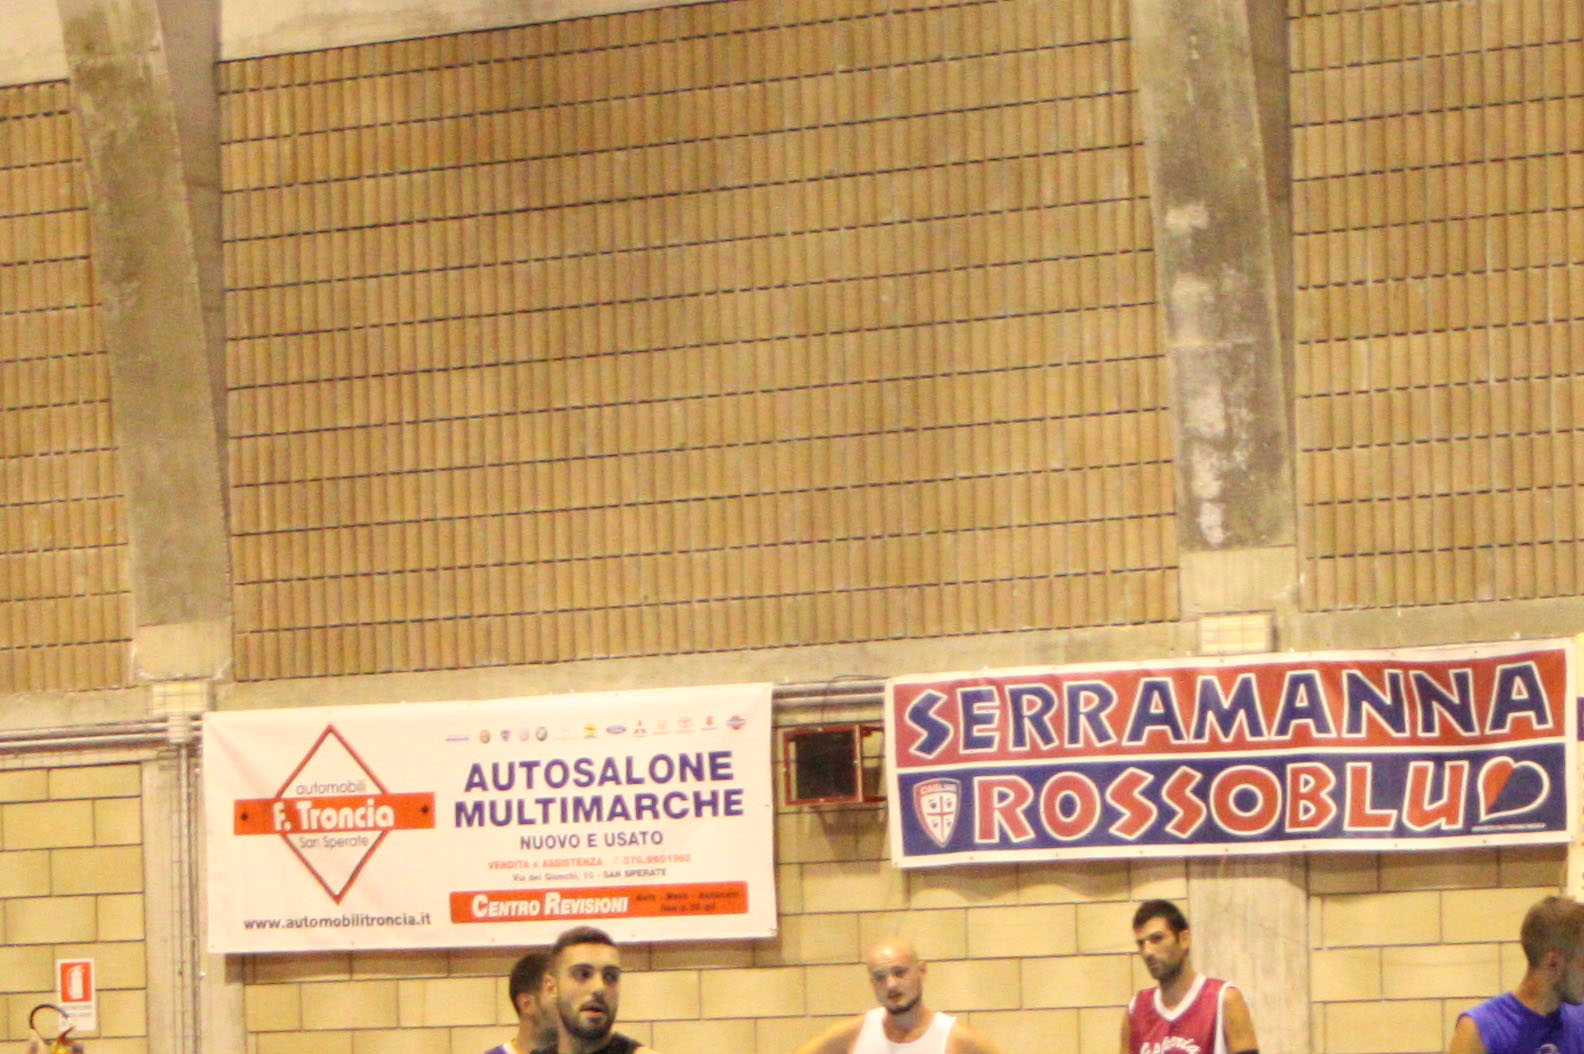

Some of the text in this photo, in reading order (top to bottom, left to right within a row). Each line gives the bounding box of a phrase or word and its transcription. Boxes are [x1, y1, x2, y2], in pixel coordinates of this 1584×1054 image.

[906, 661, 1553, 759] SERRAMANNA
[464, 751, 734, 792] AUTOSALONE
[296, 780, 367, 795] automobili
[973, 757, 1469, 845] ROSSOBLU
[296, 798, 395, 831] Troncia
[455, 789, 744, 828] MULTIMARCHE
[299, 835, 369, 850] San Sperate
[520, 830, 664, 850] NUOVO E USATO
[472, 891, 629, 918] CENTRO REVISIONI
[244, 912, 432, 930] www.automobilitroncia.it
